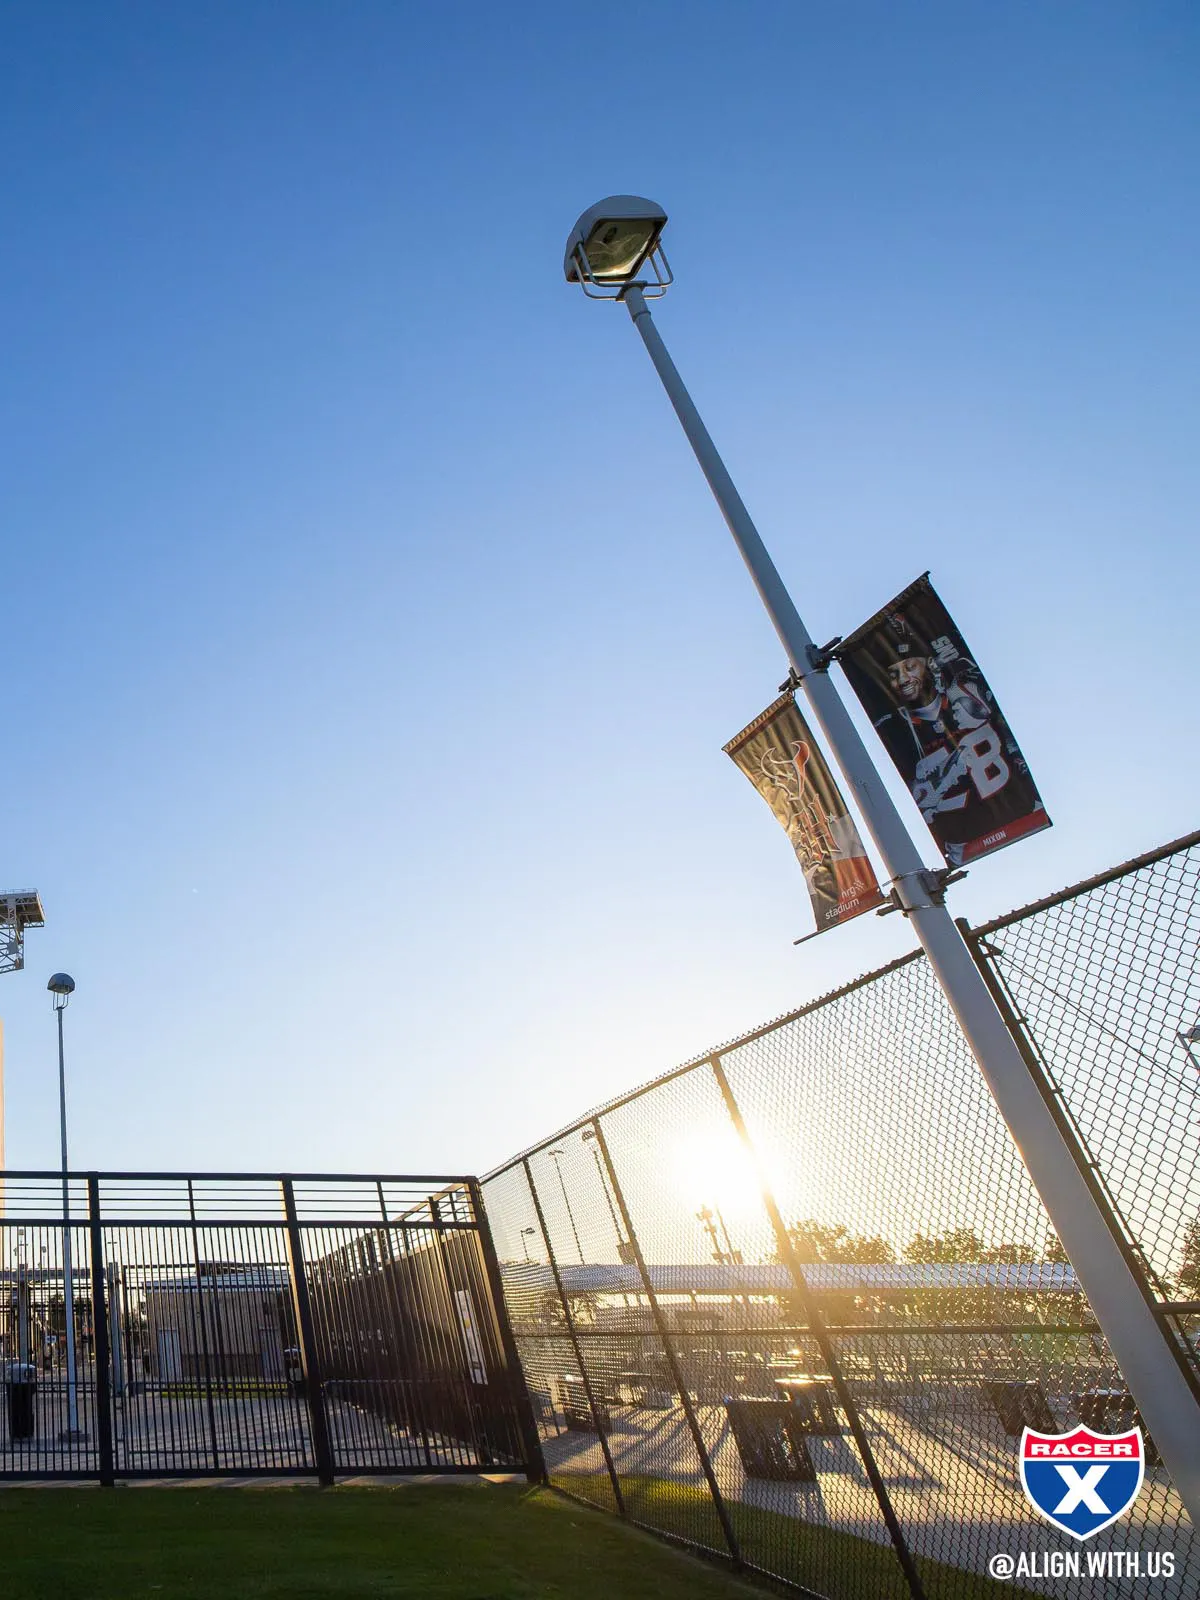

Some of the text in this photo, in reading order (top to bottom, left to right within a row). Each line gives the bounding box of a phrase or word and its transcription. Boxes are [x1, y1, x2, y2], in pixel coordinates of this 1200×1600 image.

[983, 830, 1007, 847] MIXON
[841, 882, 857, 899] nrg
[825, 897, 860, 920] stadium
